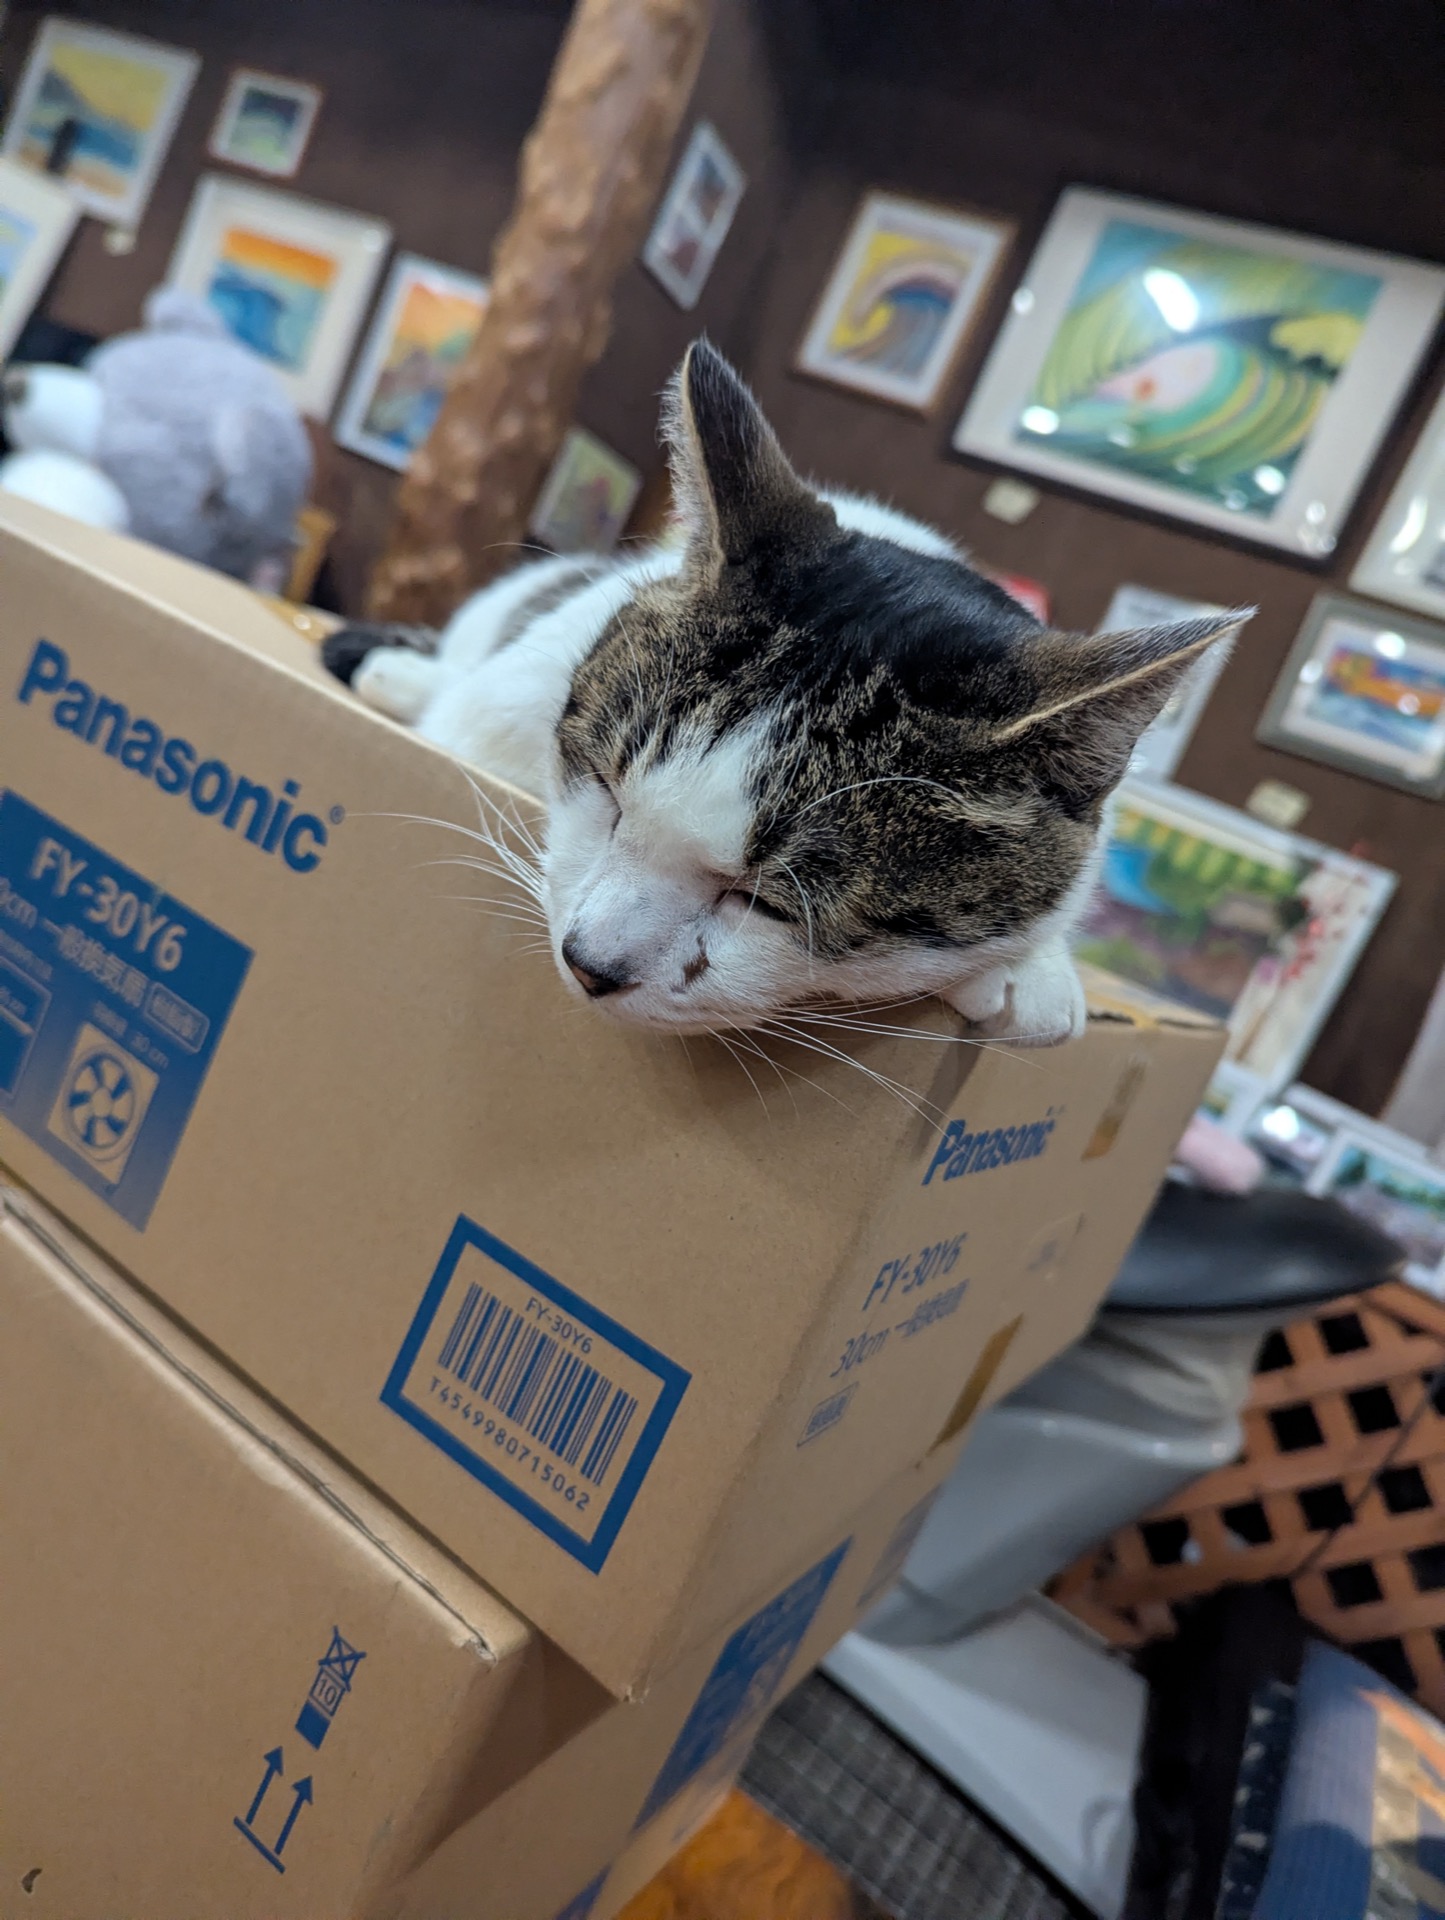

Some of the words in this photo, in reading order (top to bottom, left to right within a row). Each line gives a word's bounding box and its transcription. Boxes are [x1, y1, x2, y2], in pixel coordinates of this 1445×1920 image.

[18, 638, 328, 873] Panasonic
[30, 837, 187, 972] FY-30Y6
[921, 1105, 1056, 1186] Panasonic
[862, 1232, 967, 1312] FY-30Y6
[525, 1296, 594, 1355] FY-30Y6
[430, 1376, 591, 1511] T4549980715062
[317, 1678, 338, 1707] 10
